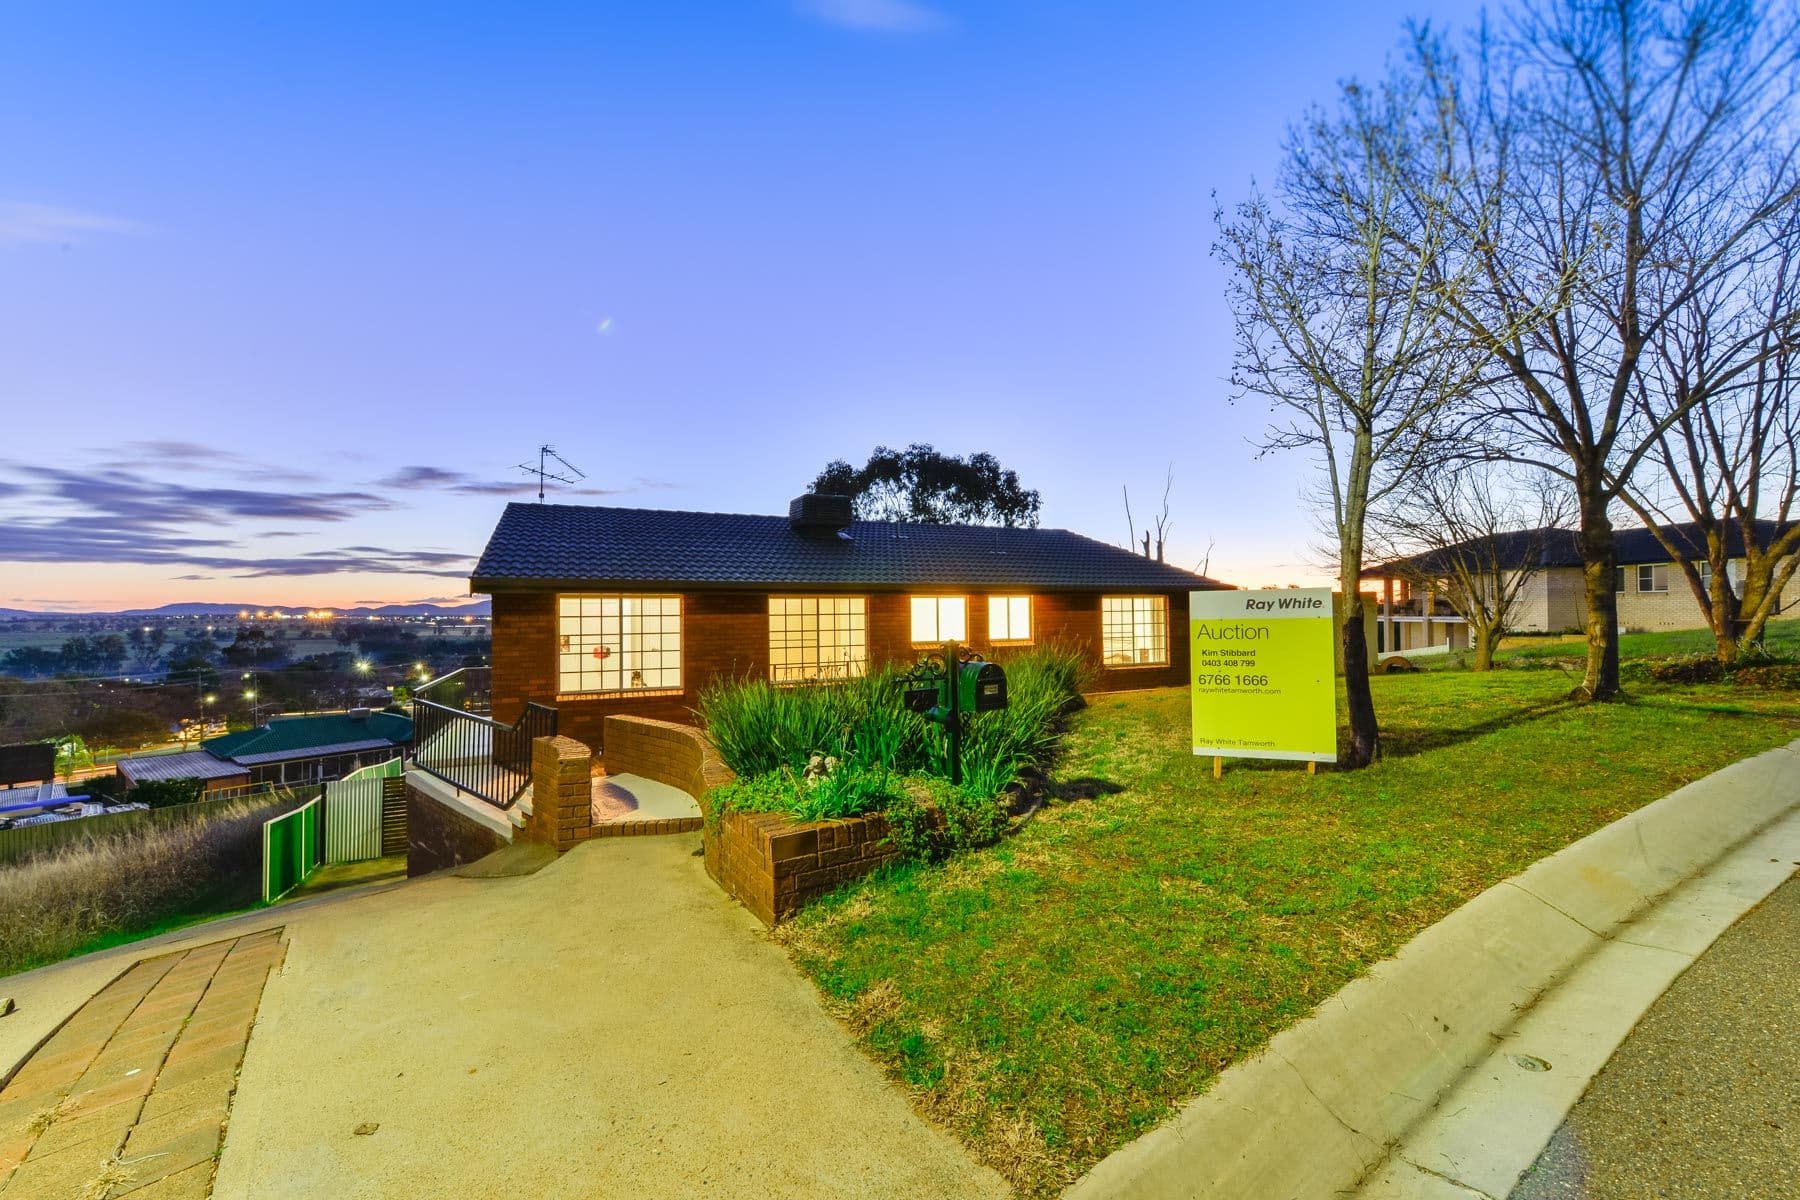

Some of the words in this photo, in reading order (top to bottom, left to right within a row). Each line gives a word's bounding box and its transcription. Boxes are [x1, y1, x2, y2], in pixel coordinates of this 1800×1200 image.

[1246, 599, 1275, 611] Ray
[1197, 623, 1270, 640] Auction
[1201, 649, 1218, 657] Kim
[1220, 649, 1256, 657] Stibbard
[1201, 659, 1222, 667] 0403
[1223, 659, 1239, 667] 408
[1240, 659, 1256, 667] 799
[1198, 674, 1231, 686] 6766
[1235, 674, 1269, 686] 1666
[1198, 687, 1281, 695] raywhitetamworth.com
[1199, 737, 1213, 746] Ray
[1238, 739, 1276, 747] Tamworth
